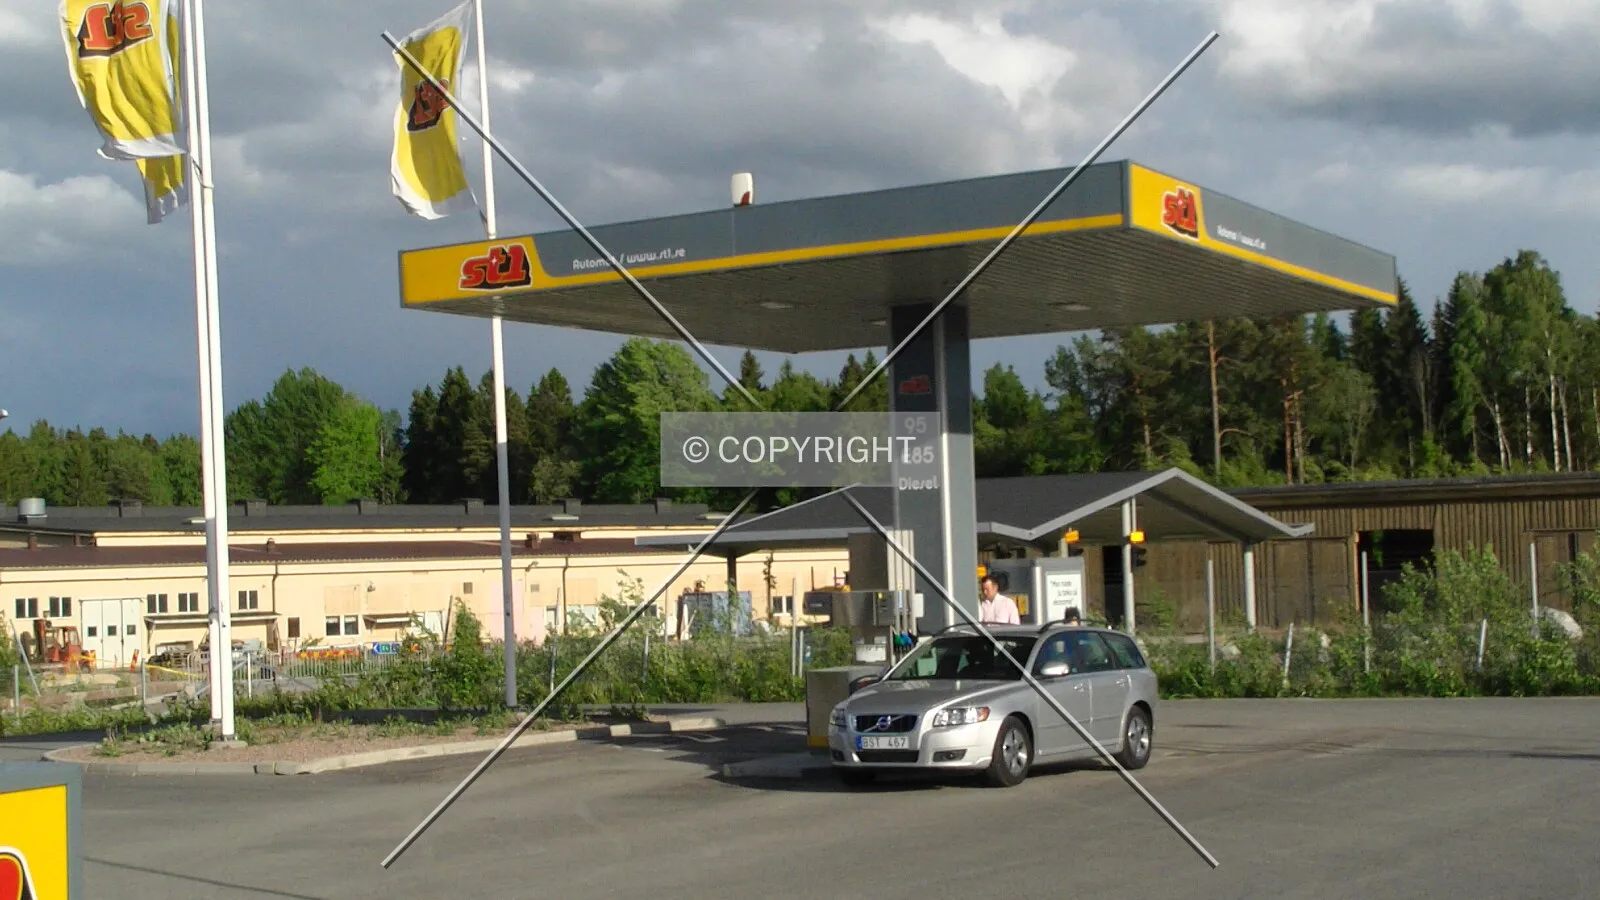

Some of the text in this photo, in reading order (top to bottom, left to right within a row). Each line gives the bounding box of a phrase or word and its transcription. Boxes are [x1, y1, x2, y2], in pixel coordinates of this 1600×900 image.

[1162, 187, 1198, 238] st1
[460, 244, 530, 289] st1
[572, 256, 616, 270] Autom
[626, 248, 686, 264] www.st1.se
[905, 417, 927, 434] 95
[899, 475, 938, 491] Diesel
